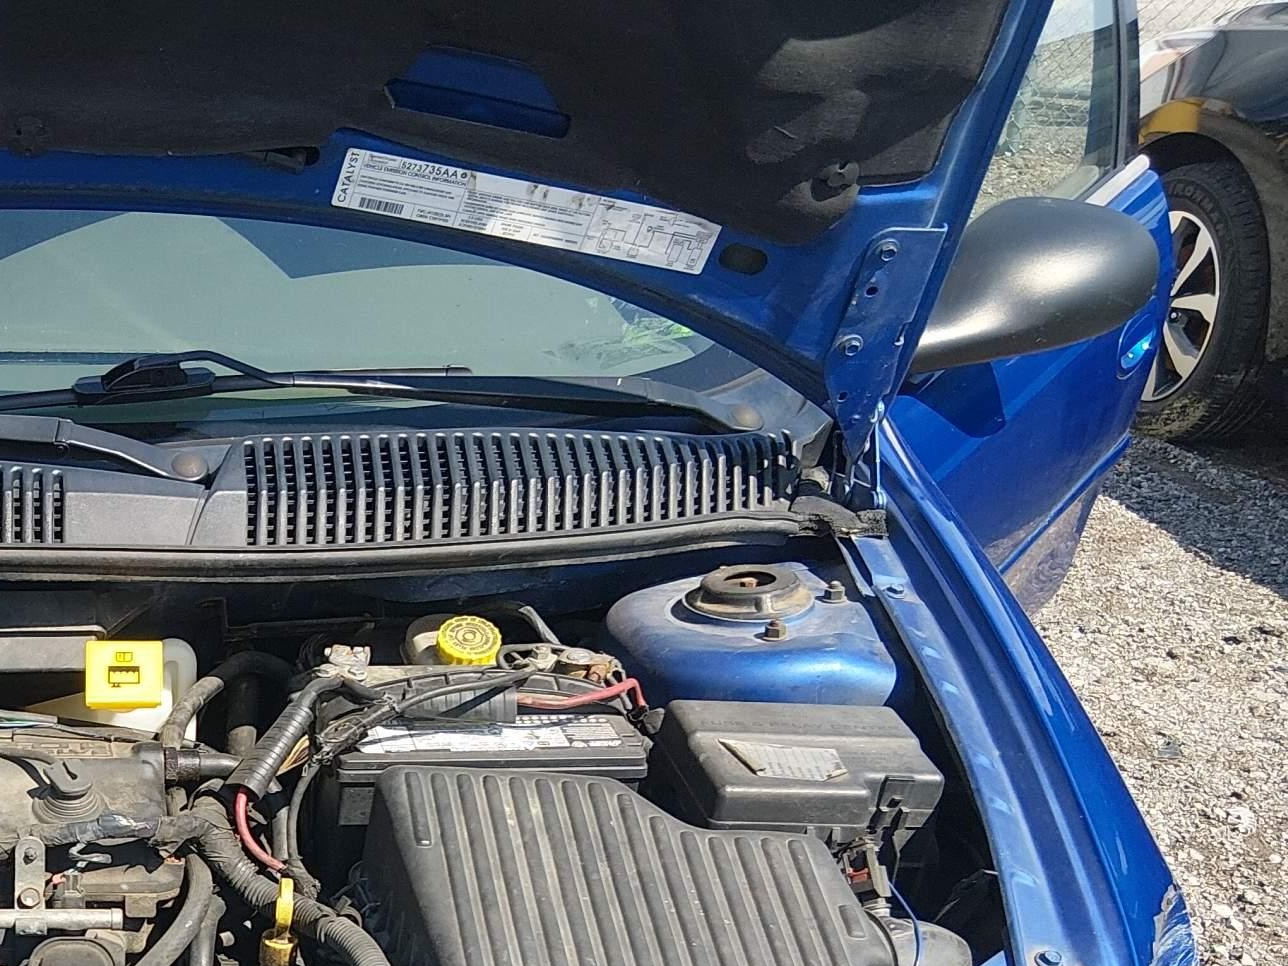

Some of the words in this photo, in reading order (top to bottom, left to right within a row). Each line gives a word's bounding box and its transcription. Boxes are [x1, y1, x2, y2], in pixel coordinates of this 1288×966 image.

[337, 151, 360, 203] CATALYST
[401, 159, 459, 180] 5273735AA
[407, 171, 432, 181] CONTROL
[432, 176, 467, 188] INFORMATION
